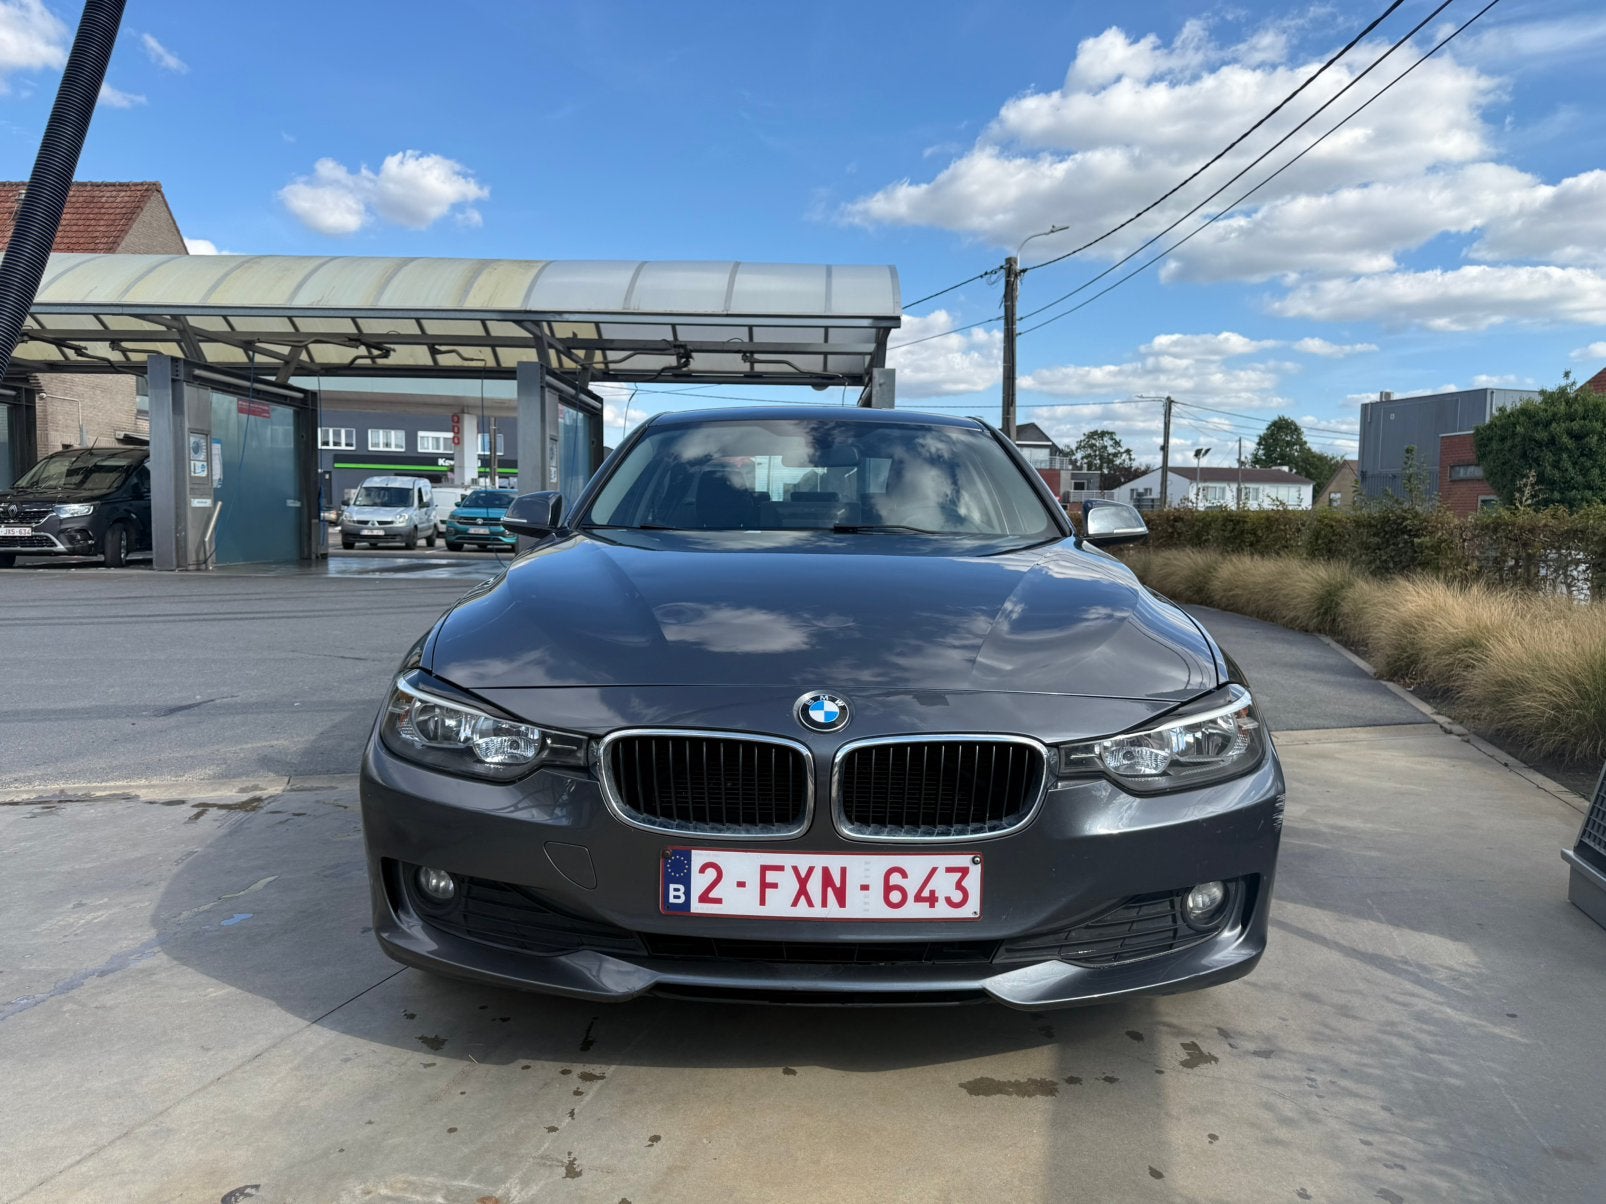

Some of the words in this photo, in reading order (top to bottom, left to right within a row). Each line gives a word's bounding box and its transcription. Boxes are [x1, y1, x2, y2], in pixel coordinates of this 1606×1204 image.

[804, 695, 845, 706] BMW
[669, 884, 686, 904] B
[697, 861, 970, 909] 2-FXN-643
